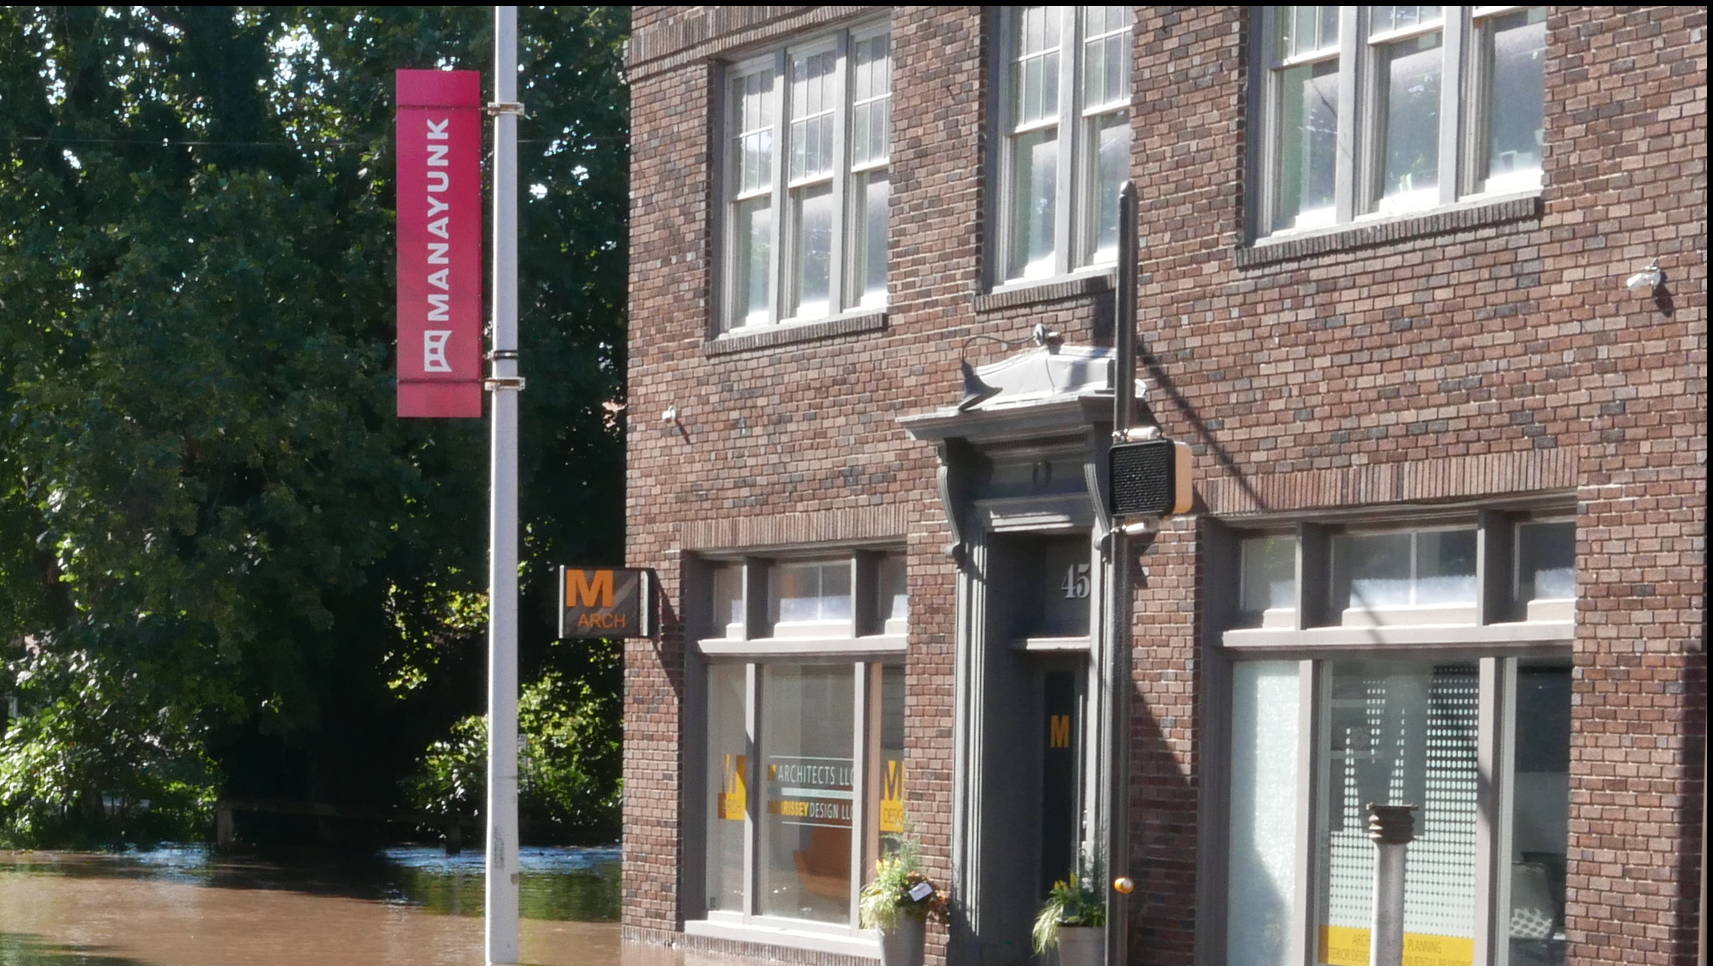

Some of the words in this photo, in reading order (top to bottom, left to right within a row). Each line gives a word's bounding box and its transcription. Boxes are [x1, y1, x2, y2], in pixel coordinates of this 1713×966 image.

[427, 118, 450, 322] MANAYUNK
[566, 568, 615, 608] M
[577, 613, 628, 629] ARCH
[1050, 715, 1071, 749] M
[777, 764, 836, 785] ARCHITECTS
[1407, 938, 1442, 954] PLANNING
